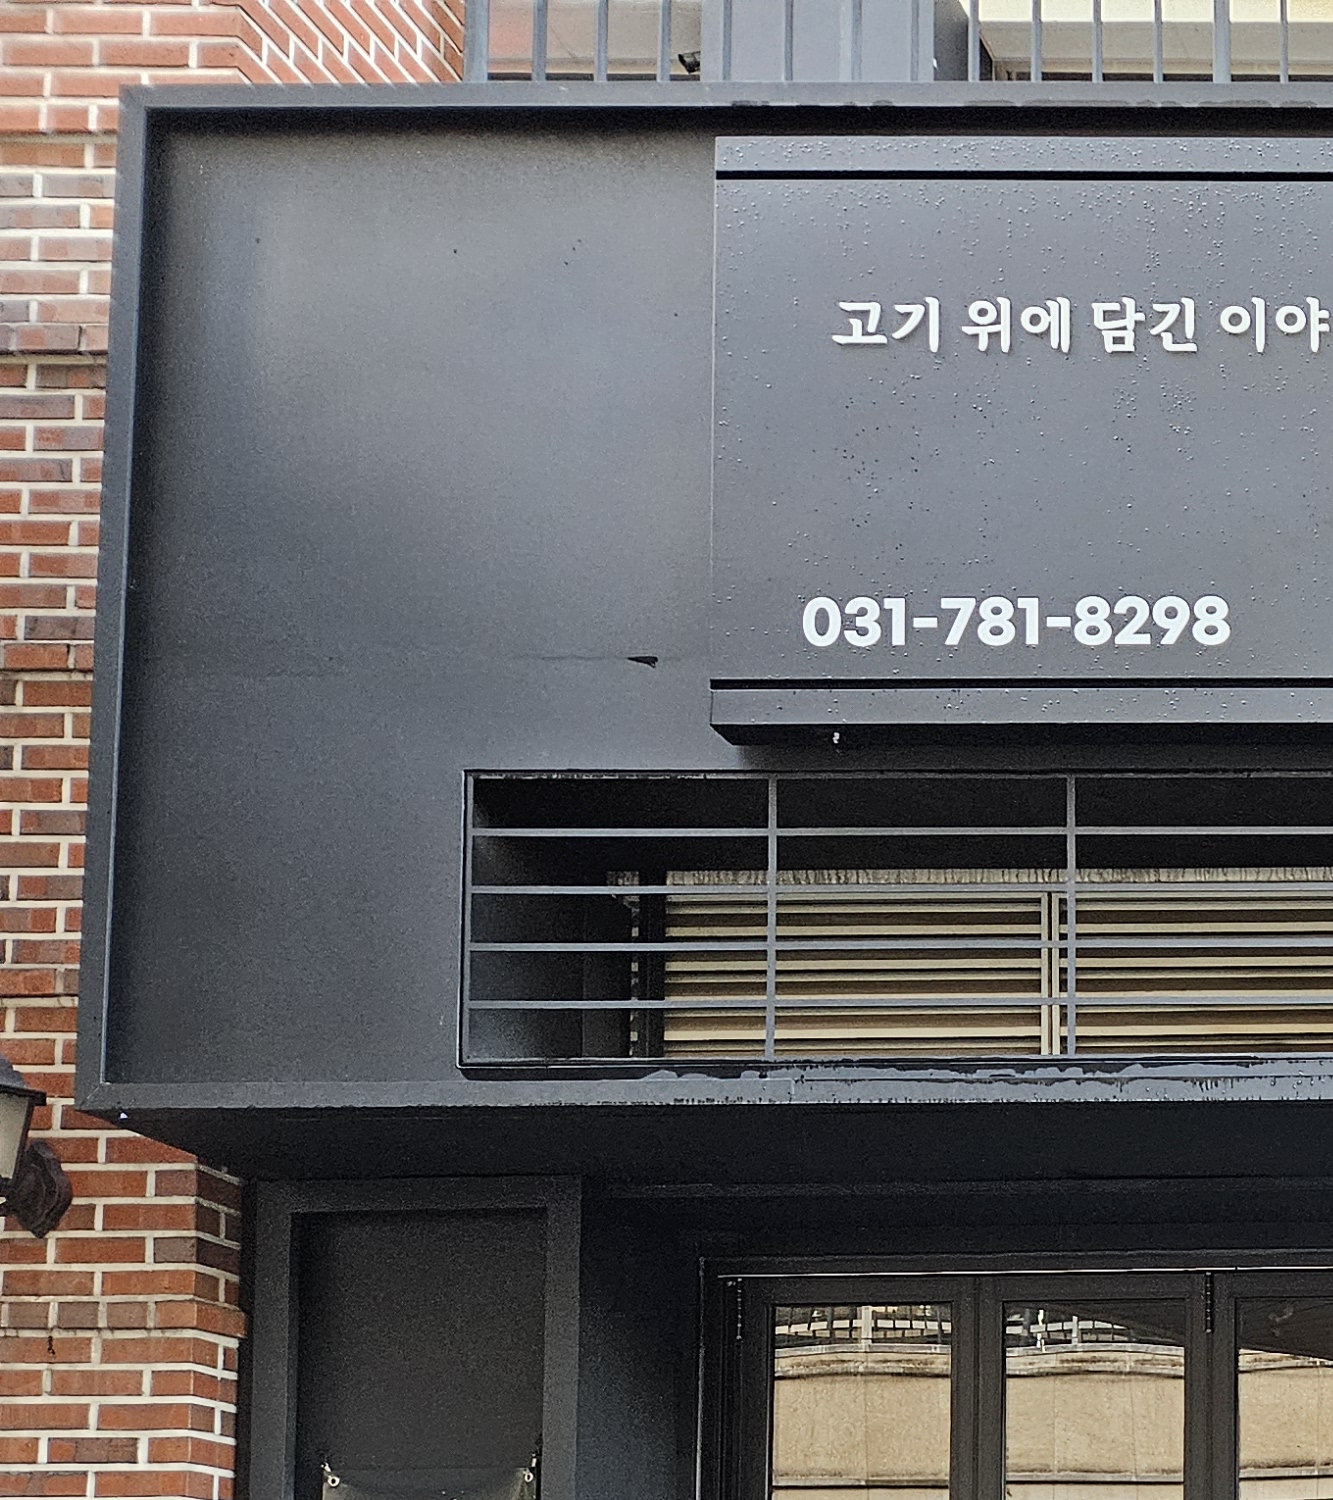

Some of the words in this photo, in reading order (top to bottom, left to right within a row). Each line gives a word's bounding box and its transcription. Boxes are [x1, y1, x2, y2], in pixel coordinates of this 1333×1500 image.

[831, 298, 940, 352] 고기
[962, 297, 1071, 353] 위에
[1092, 297, 1198, 353] 담긴
[802, 596, 1231, 646] 031-781-8298
